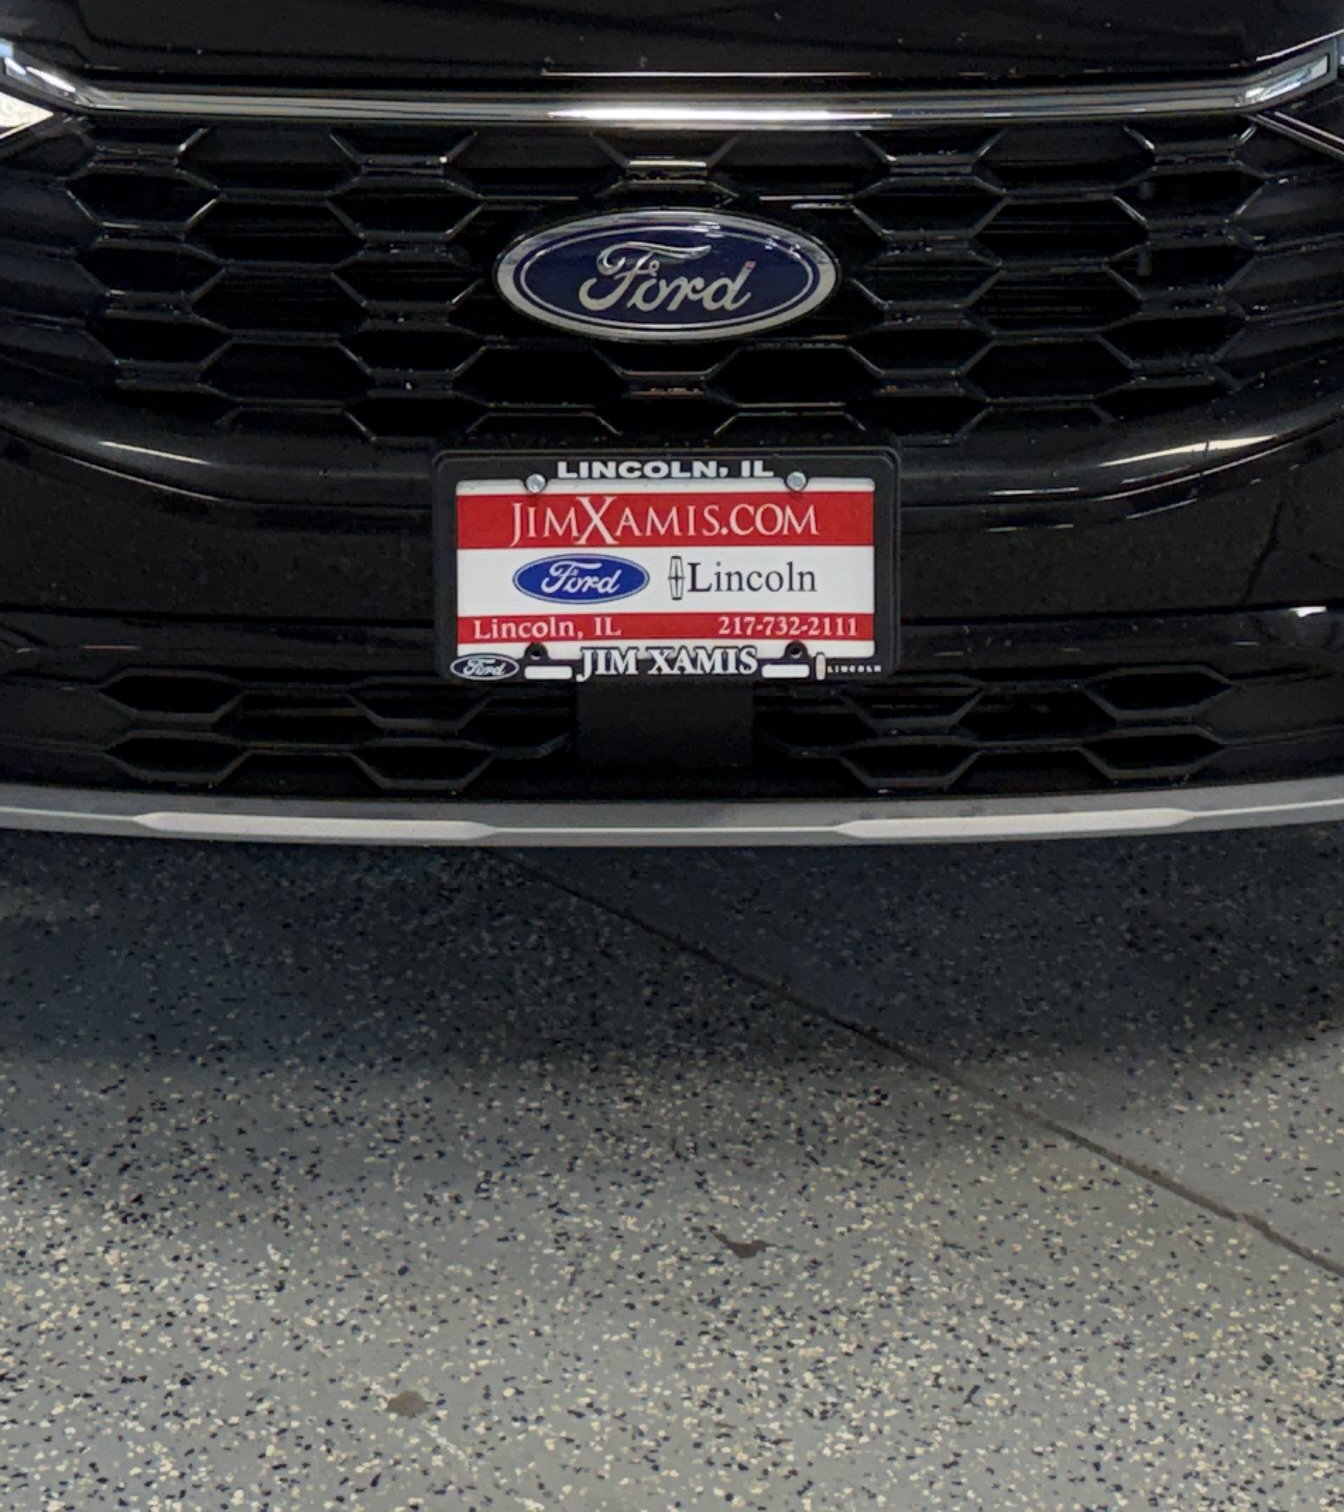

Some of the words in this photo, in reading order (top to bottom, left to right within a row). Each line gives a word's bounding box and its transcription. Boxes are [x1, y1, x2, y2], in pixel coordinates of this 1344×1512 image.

[578, 240, 757, 312] Ford
[556, 460, 729, 479] LINCOLN,
[741, 460, 774, 477] IL
[510, 496, 819, 548] JIMXAMIS.COM
[541, 560, 622, 594] Ford
[687, 562, 817, 593] Lincoln
[473, 617, 584, 640] Lincoln,
[594, 617, 622, 636] IL
[718, 616, 858, 637] 217-732-2111
[575, 647, 640, 683] JIM
[645, 646, 758, 676] XAMIS
